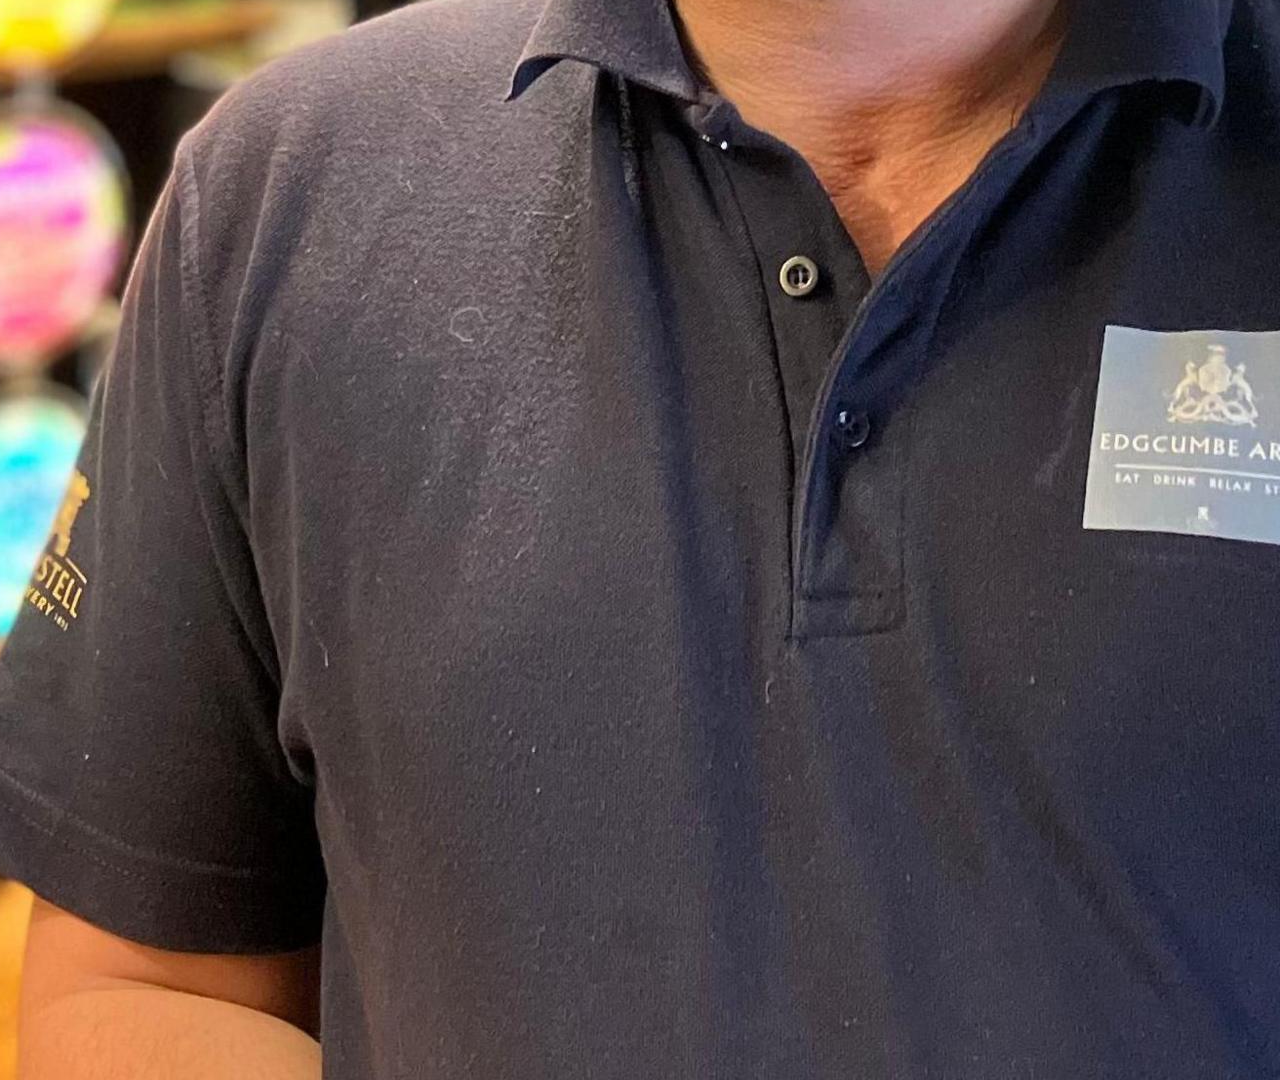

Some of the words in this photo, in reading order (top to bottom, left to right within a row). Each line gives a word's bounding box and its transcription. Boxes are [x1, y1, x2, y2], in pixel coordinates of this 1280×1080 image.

[1099, 432, 1241, 458] EDGCUMBE
[1114, 472, 1141, 484] EAT
[1153, 475, 1197, 487] DRINK
[1209, 478, 1252, 492] RELAX
